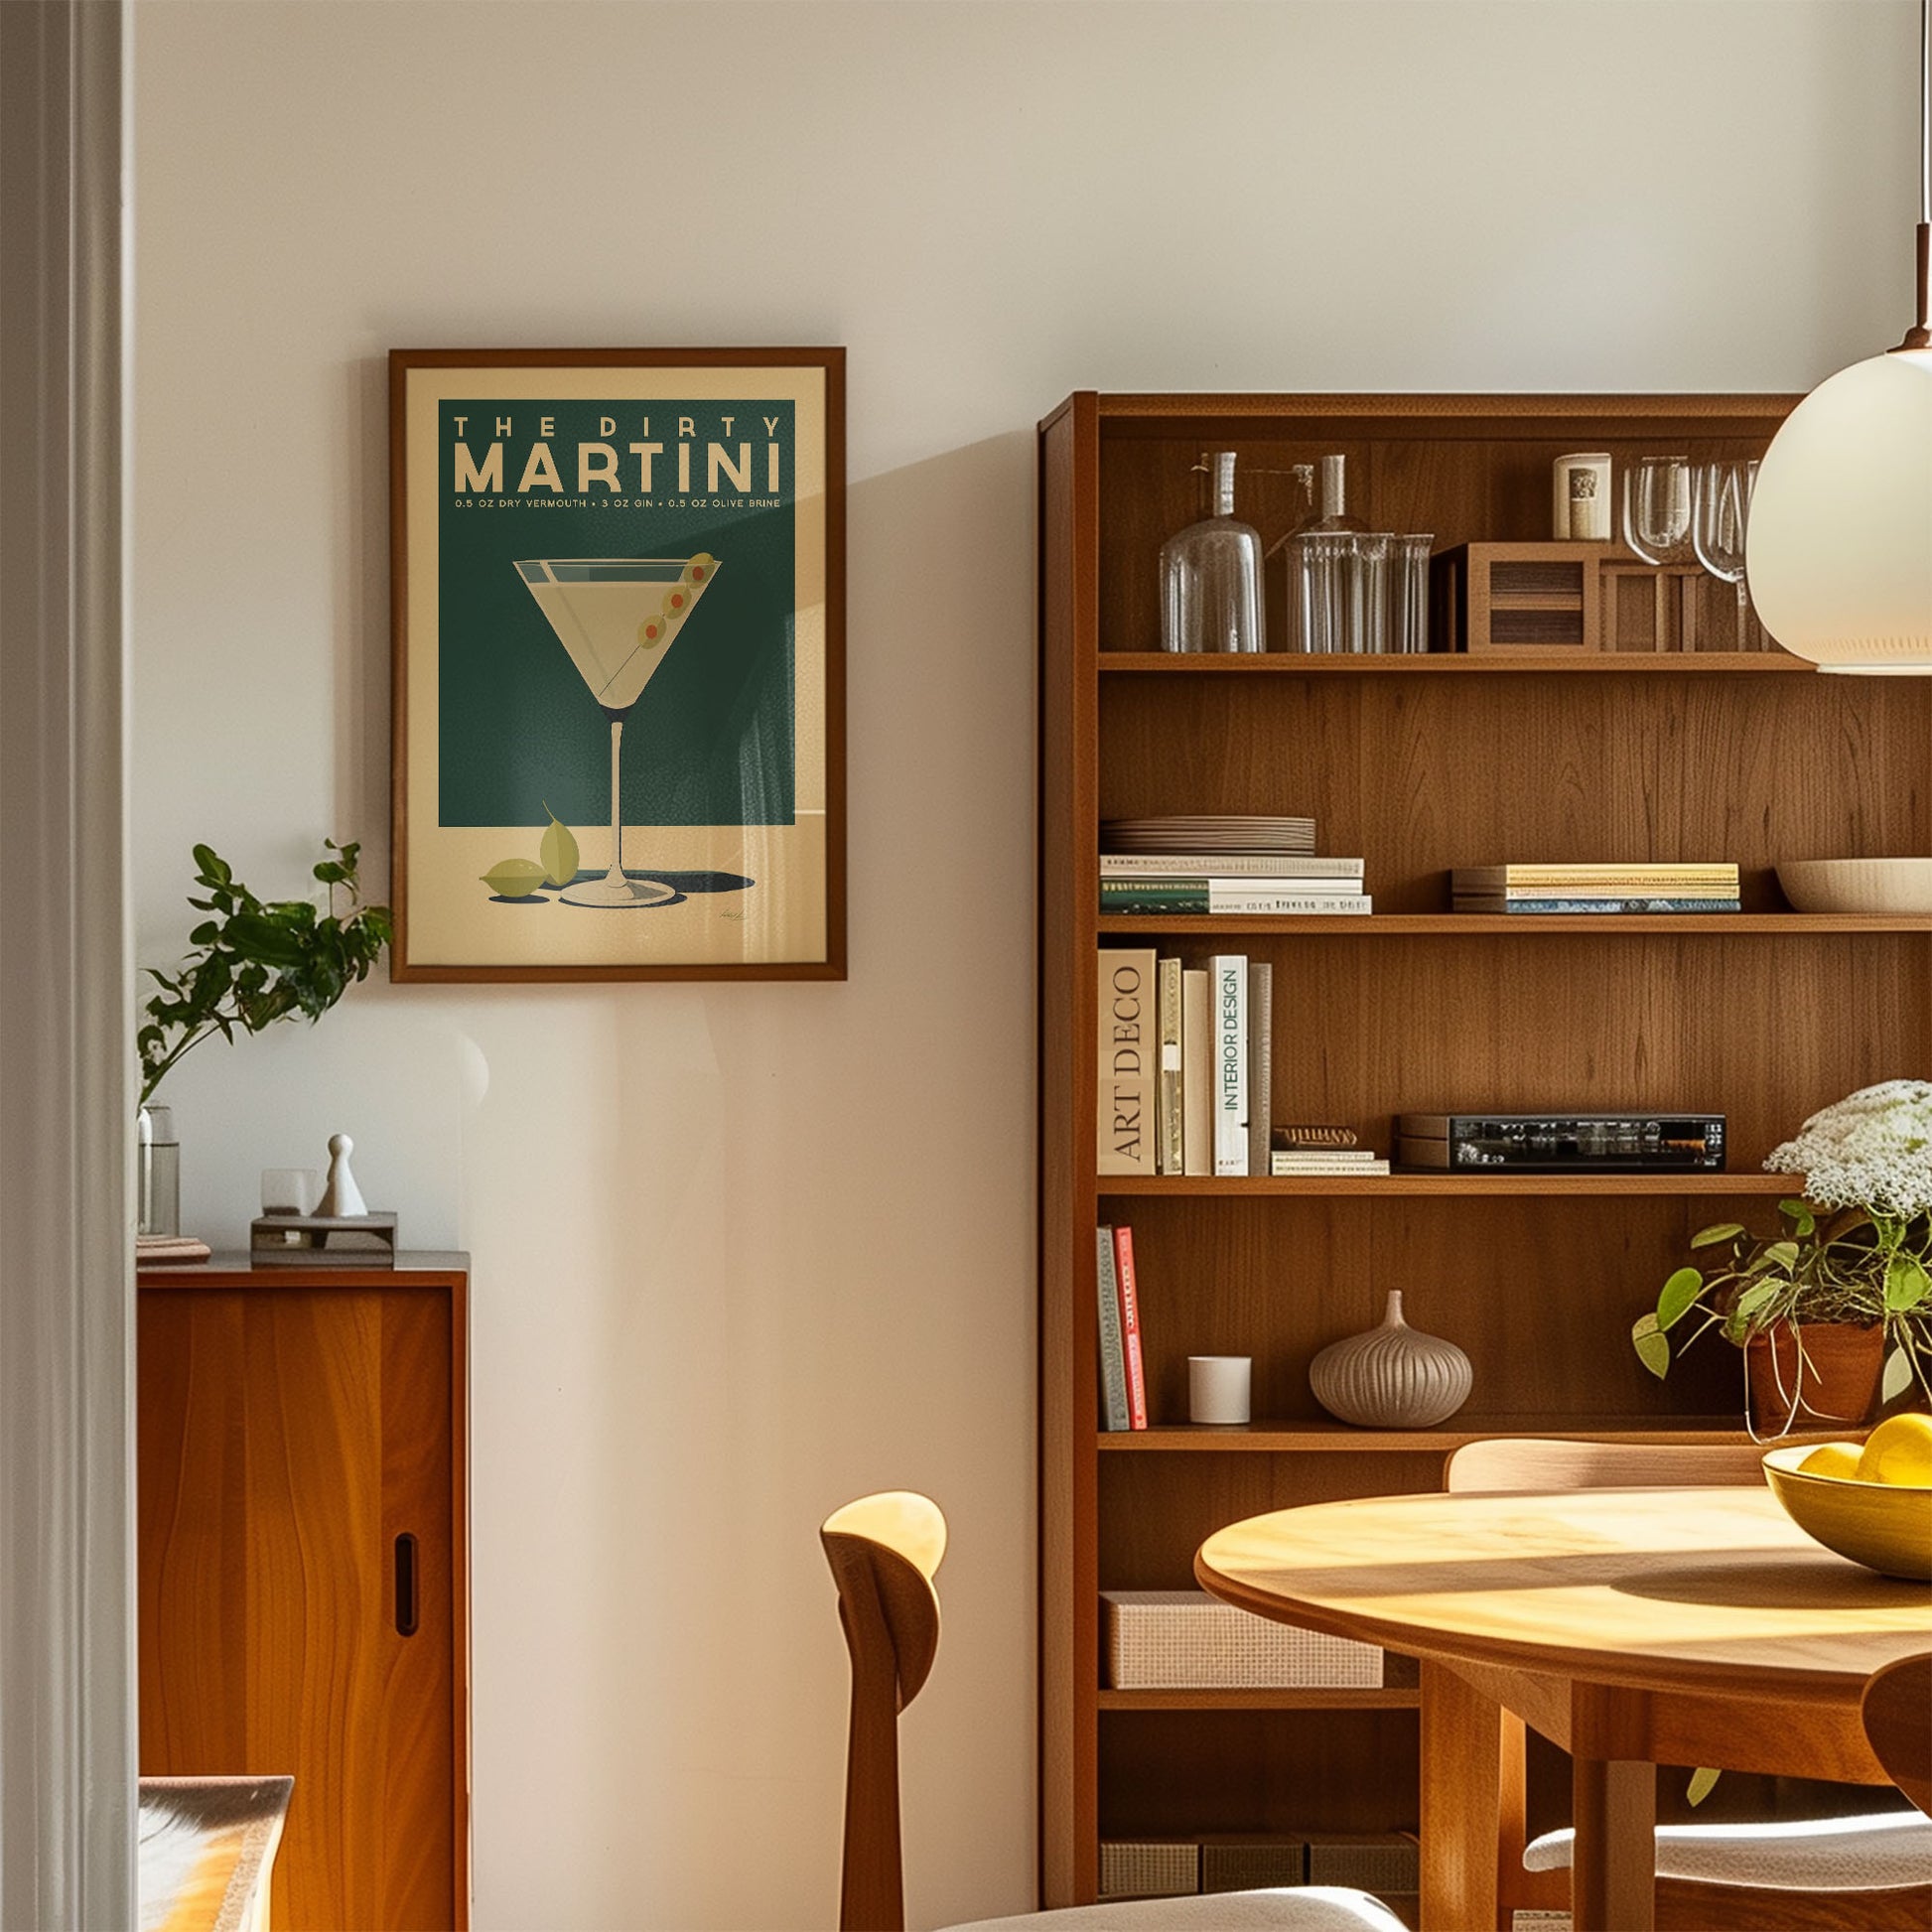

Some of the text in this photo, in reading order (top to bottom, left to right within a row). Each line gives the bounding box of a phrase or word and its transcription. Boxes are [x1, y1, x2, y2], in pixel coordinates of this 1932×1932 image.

[454, 416, 779, 438] THE DIRTY
[454, 442, 779, 493] MARTINI
[455, 498, 780, 508] 0.5 OZ DRY VERMOUTH 3 OZ GIN 0.5 OZ OLIVE BRINE
[1113, 966, 1141, 1161] ART DECO
[1223, 969, 1238, 1111] INTERIOR DESIGN
